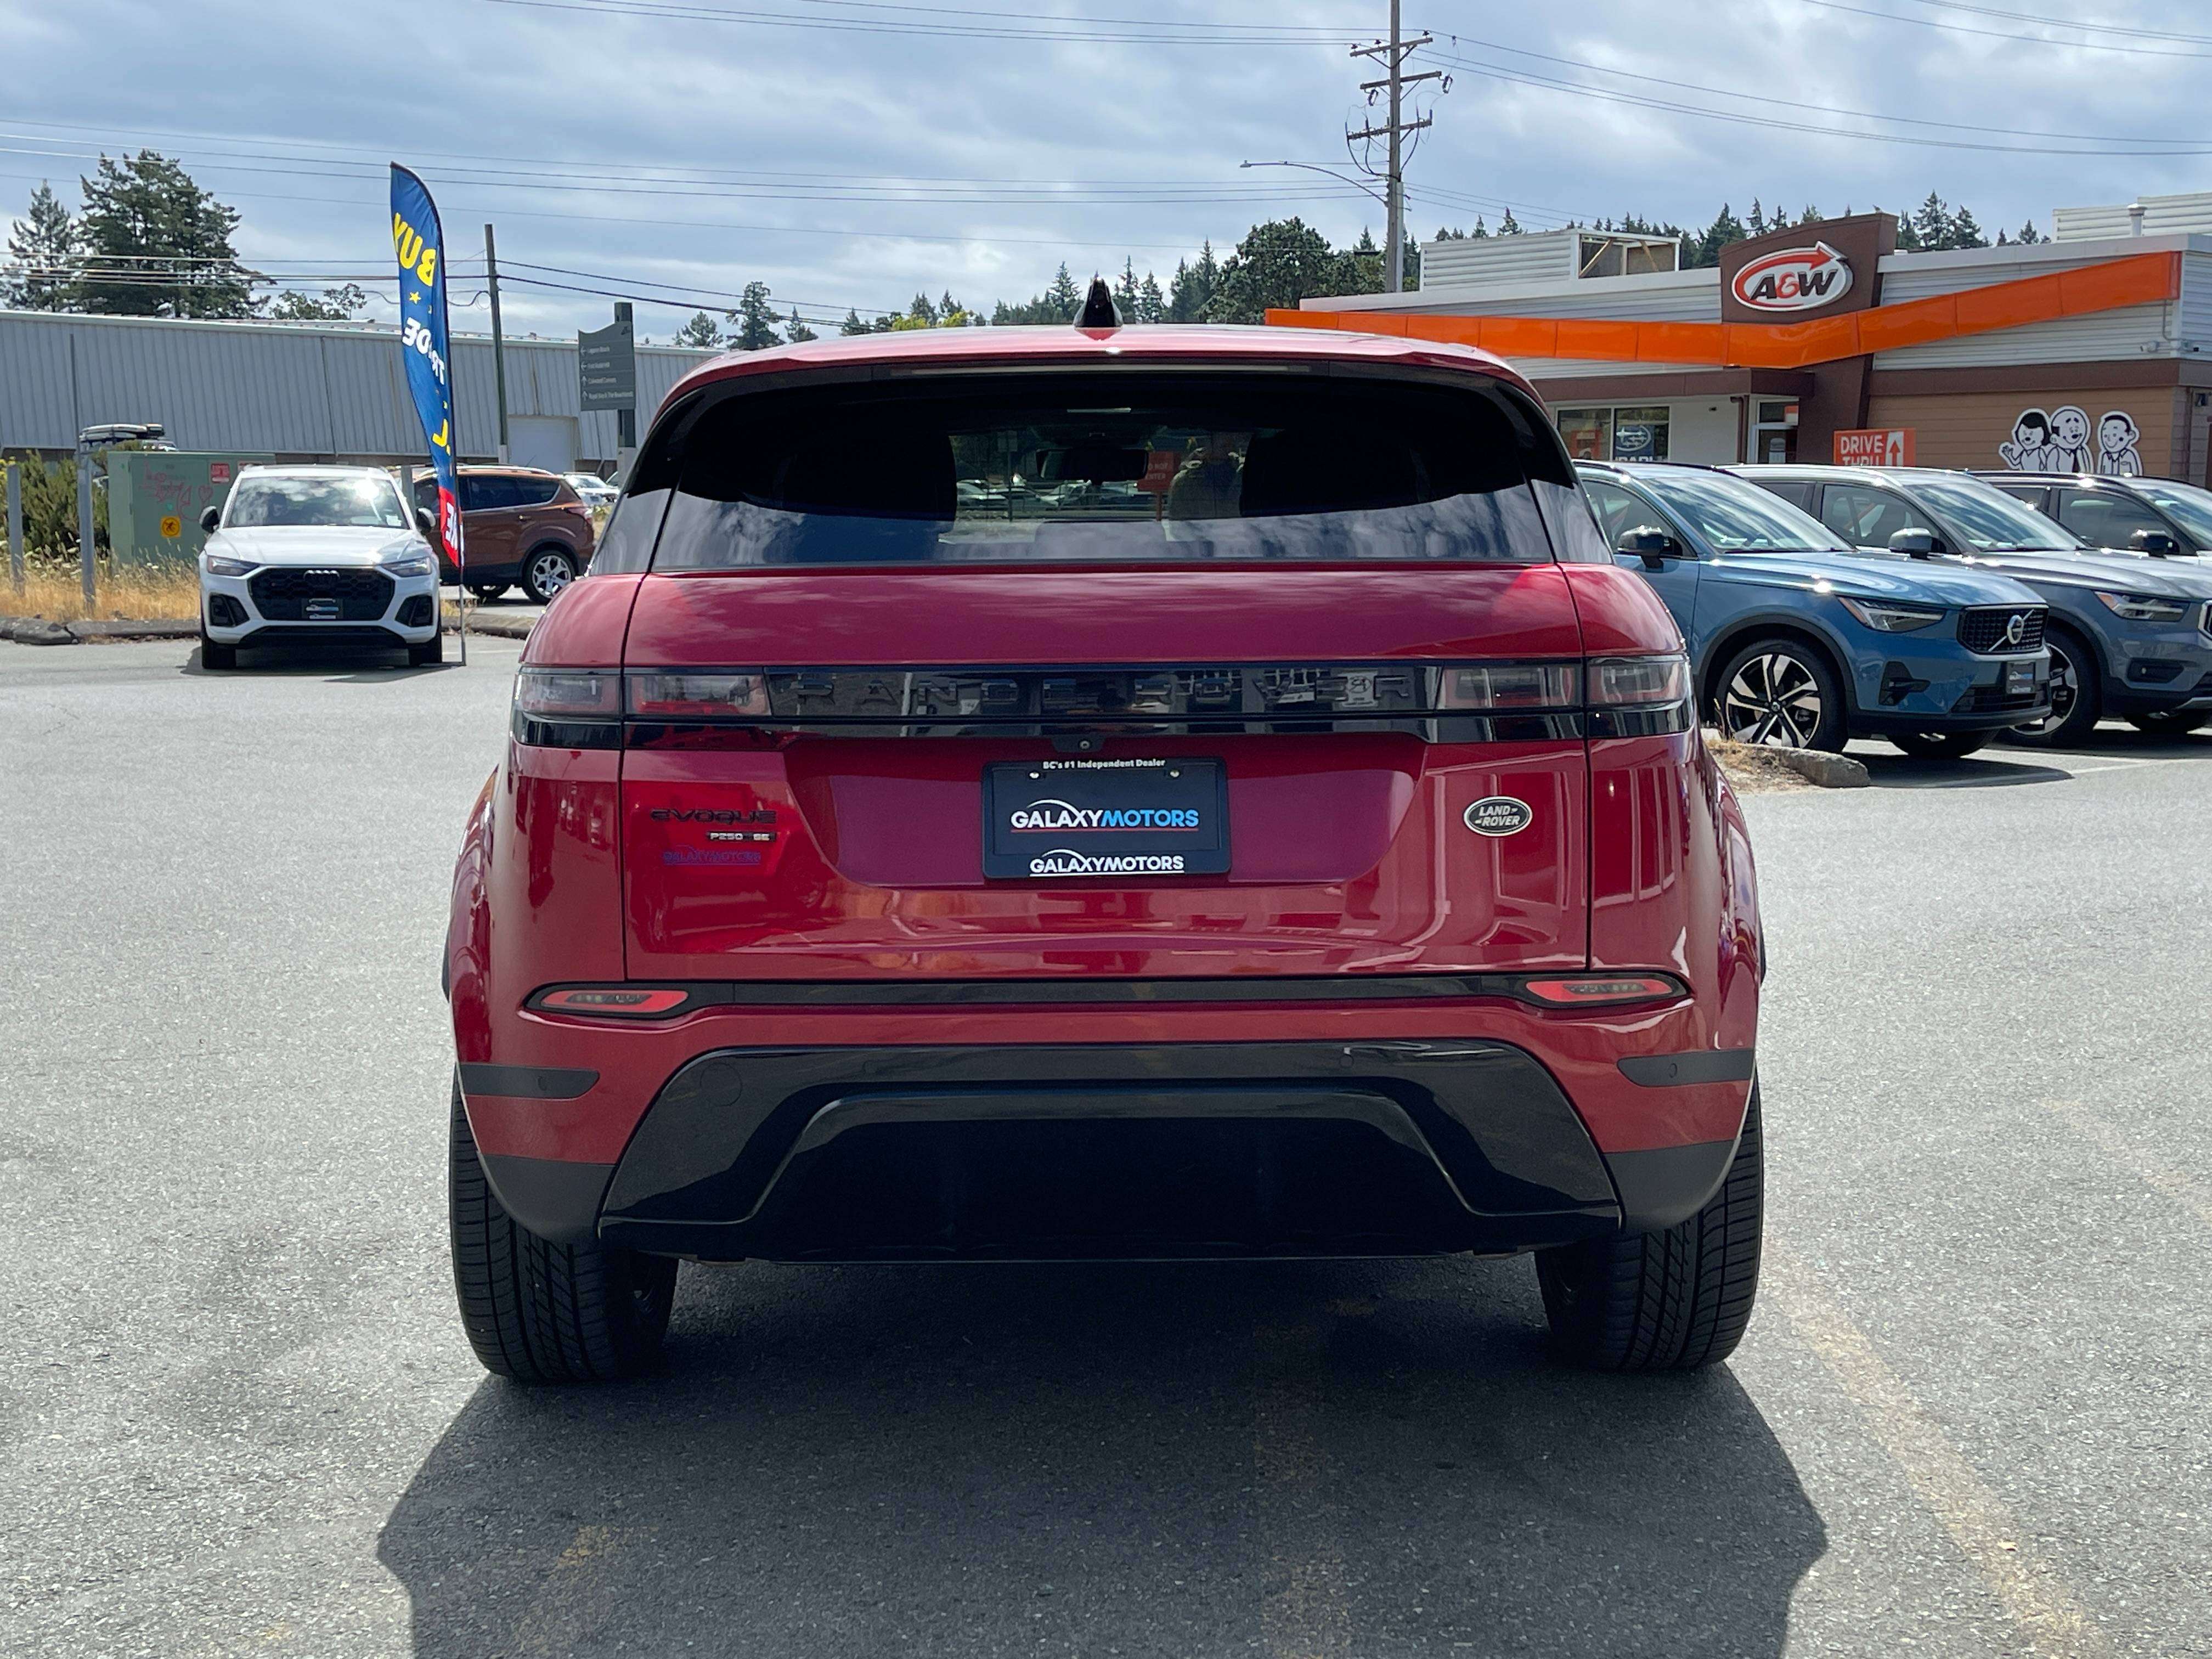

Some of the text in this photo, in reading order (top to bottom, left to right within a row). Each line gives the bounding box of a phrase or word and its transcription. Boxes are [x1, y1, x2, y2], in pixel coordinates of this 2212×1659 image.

[1749, 269, 1838, 300] A&W
[1840, 435, 1883, 455] DRIVE
[1043, 761, 1063, 769] BC's
[1077, 760, 1134, 769] Independent
[1136, 759, 1166, 767] Dealer
[650, 809, 777, 825] EVOQUE
[1011, 809, 1199, 828] GALAXYMOTORS
[710, 832, 770, 841] P250 SE
[1030, 856, 1186, 873] GALAXYMOTORS
